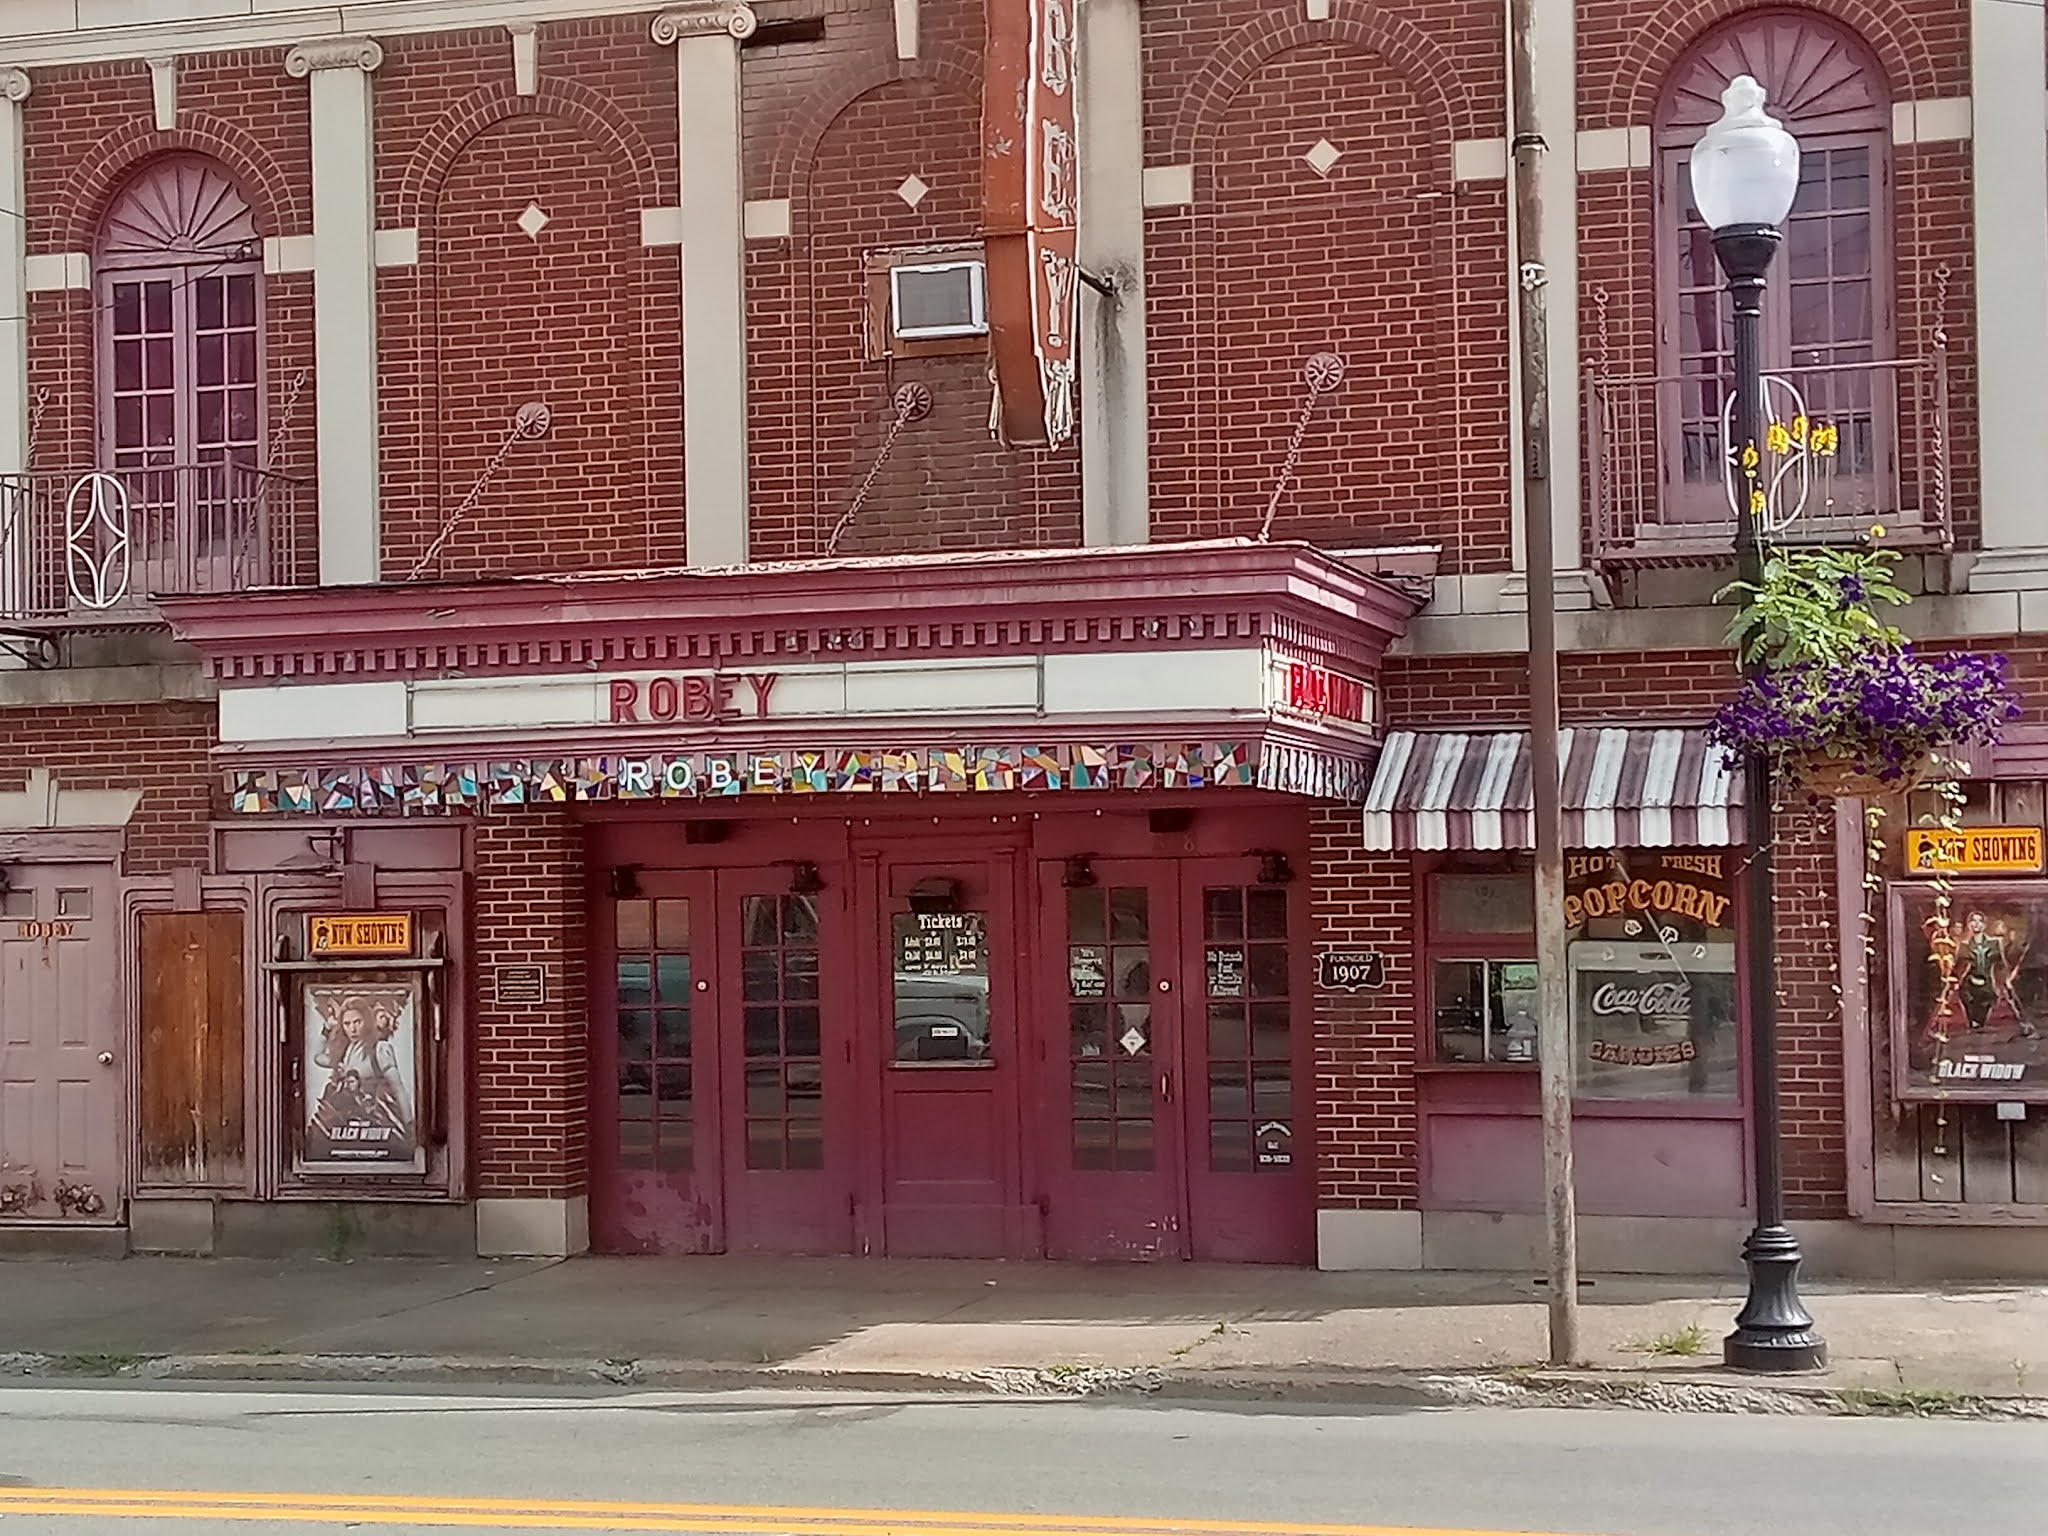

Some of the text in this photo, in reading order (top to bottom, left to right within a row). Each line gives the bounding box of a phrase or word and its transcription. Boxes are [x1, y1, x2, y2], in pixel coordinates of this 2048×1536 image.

[609, 672, 779, 723] ROBEY
[625, 755, 821, 792] ROBEY
[1973, 836, 2037, 862] SHOWING
[1567, 854, 1724, 879] HOT FRESH
[1564, 878, 1731, 928] POPCORN
[330, 922, 405, 945] NOW SHOWING
[917, 913, 963, 930] Tickets
[1329, 954, 1374, 964] FOUNDED
[1332, 964, 1372, 984] 1907
[1589, 1039, 1697, 1066] CANDIES
[1937, 1061, 2026, 1080] BLACK WIDOW
